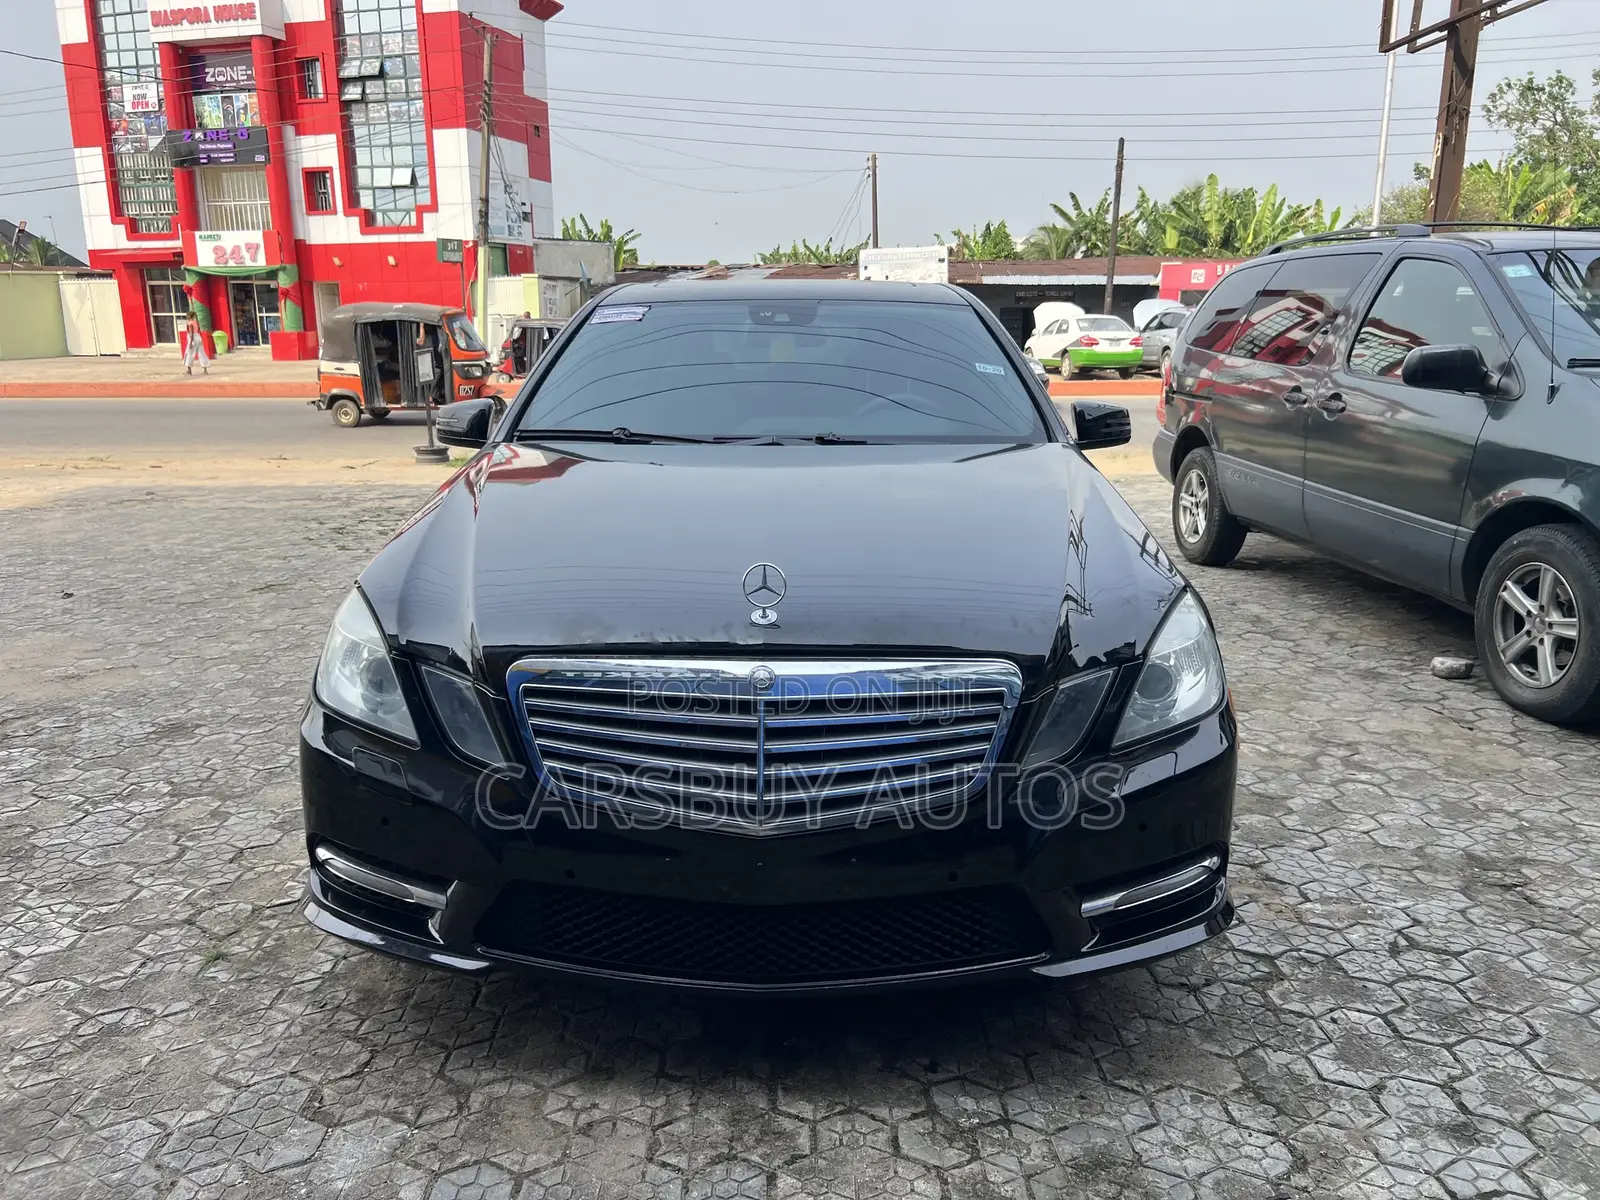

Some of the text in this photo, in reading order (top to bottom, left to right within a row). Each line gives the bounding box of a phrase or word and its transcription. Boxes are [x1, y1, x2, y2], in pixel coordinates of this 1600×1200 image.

[150, 2, 256, 27] DIASPORA HOUSE
[132, 100, 150, 110] OPEN
[212, 242, 260, 265] 247
